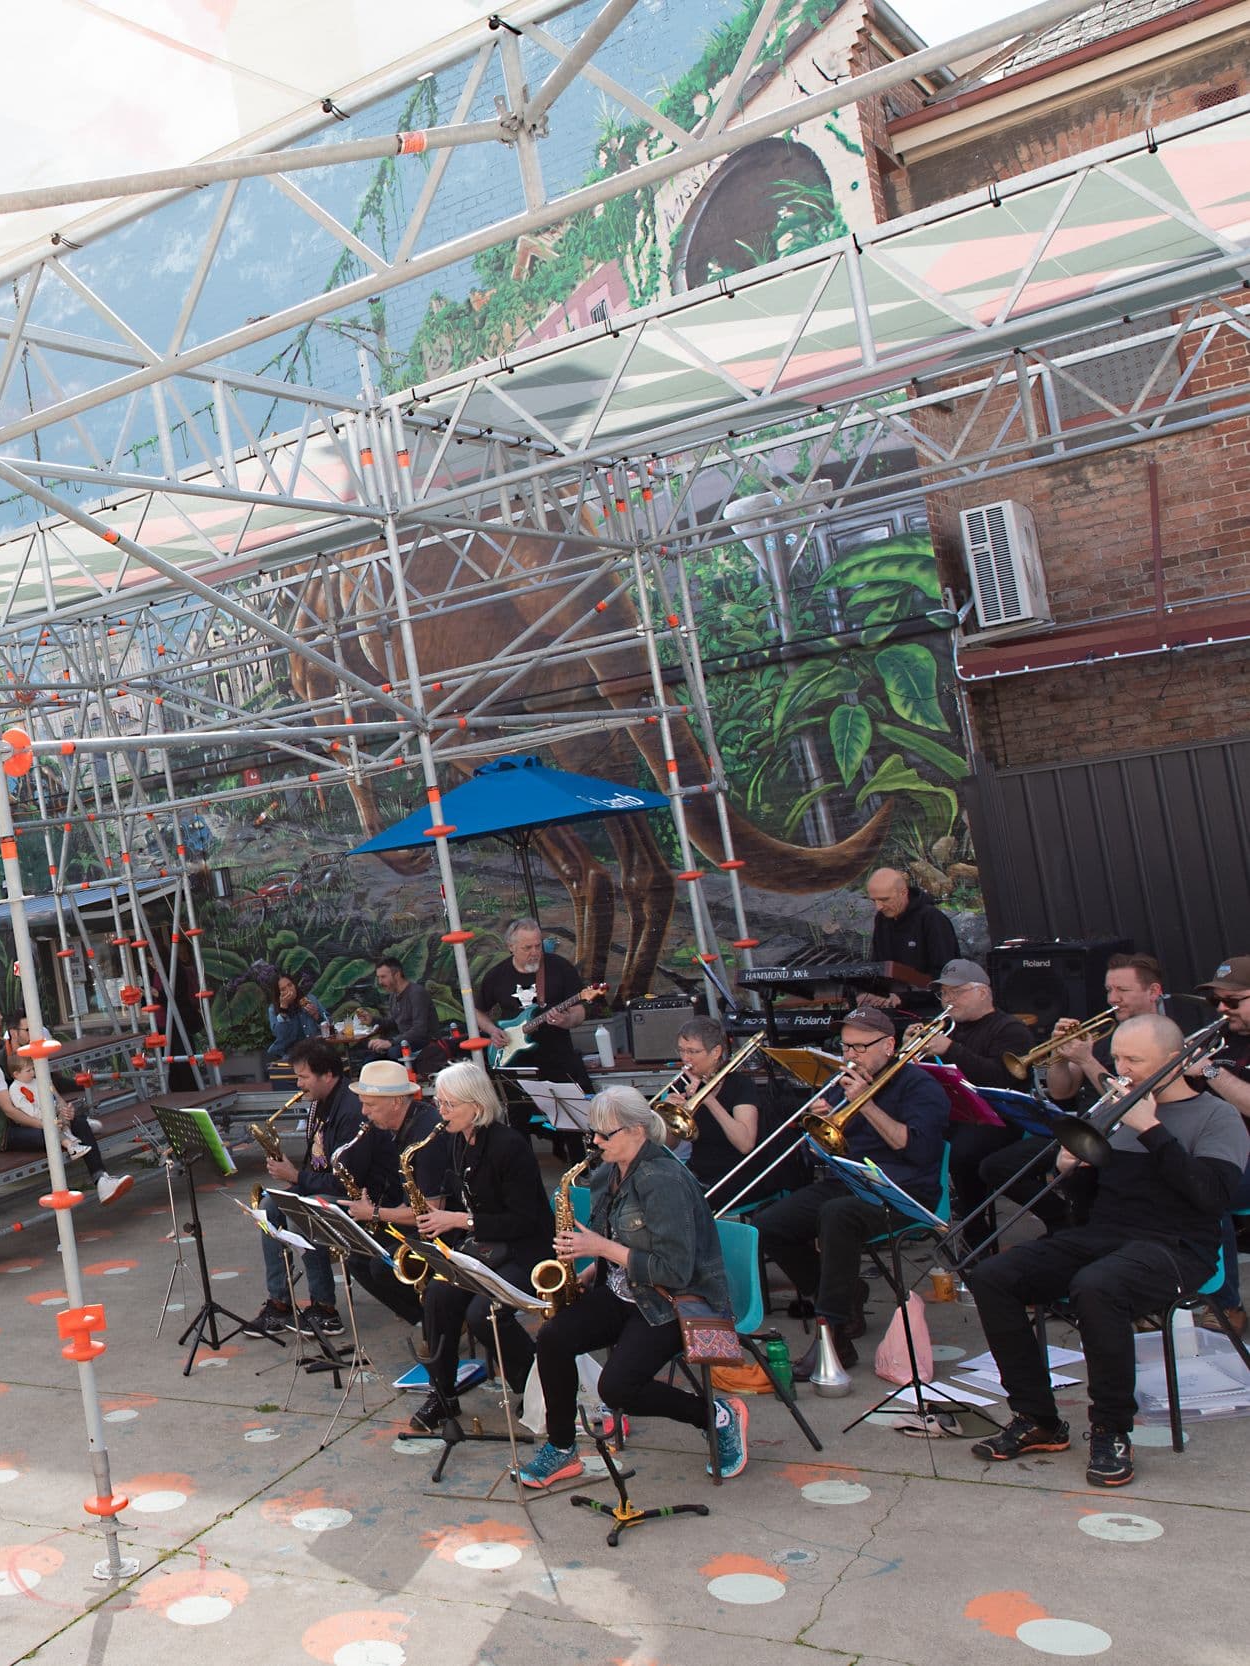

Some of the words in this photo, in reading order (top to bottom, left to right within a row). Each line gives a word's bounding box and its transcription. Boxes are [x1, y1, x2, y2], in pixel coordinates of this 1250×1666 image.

[1022, 959, 1051, 967] Roland
[745, 970, 790, 980] HAMMOND
[793, 1015, 832, 1025] Roland
